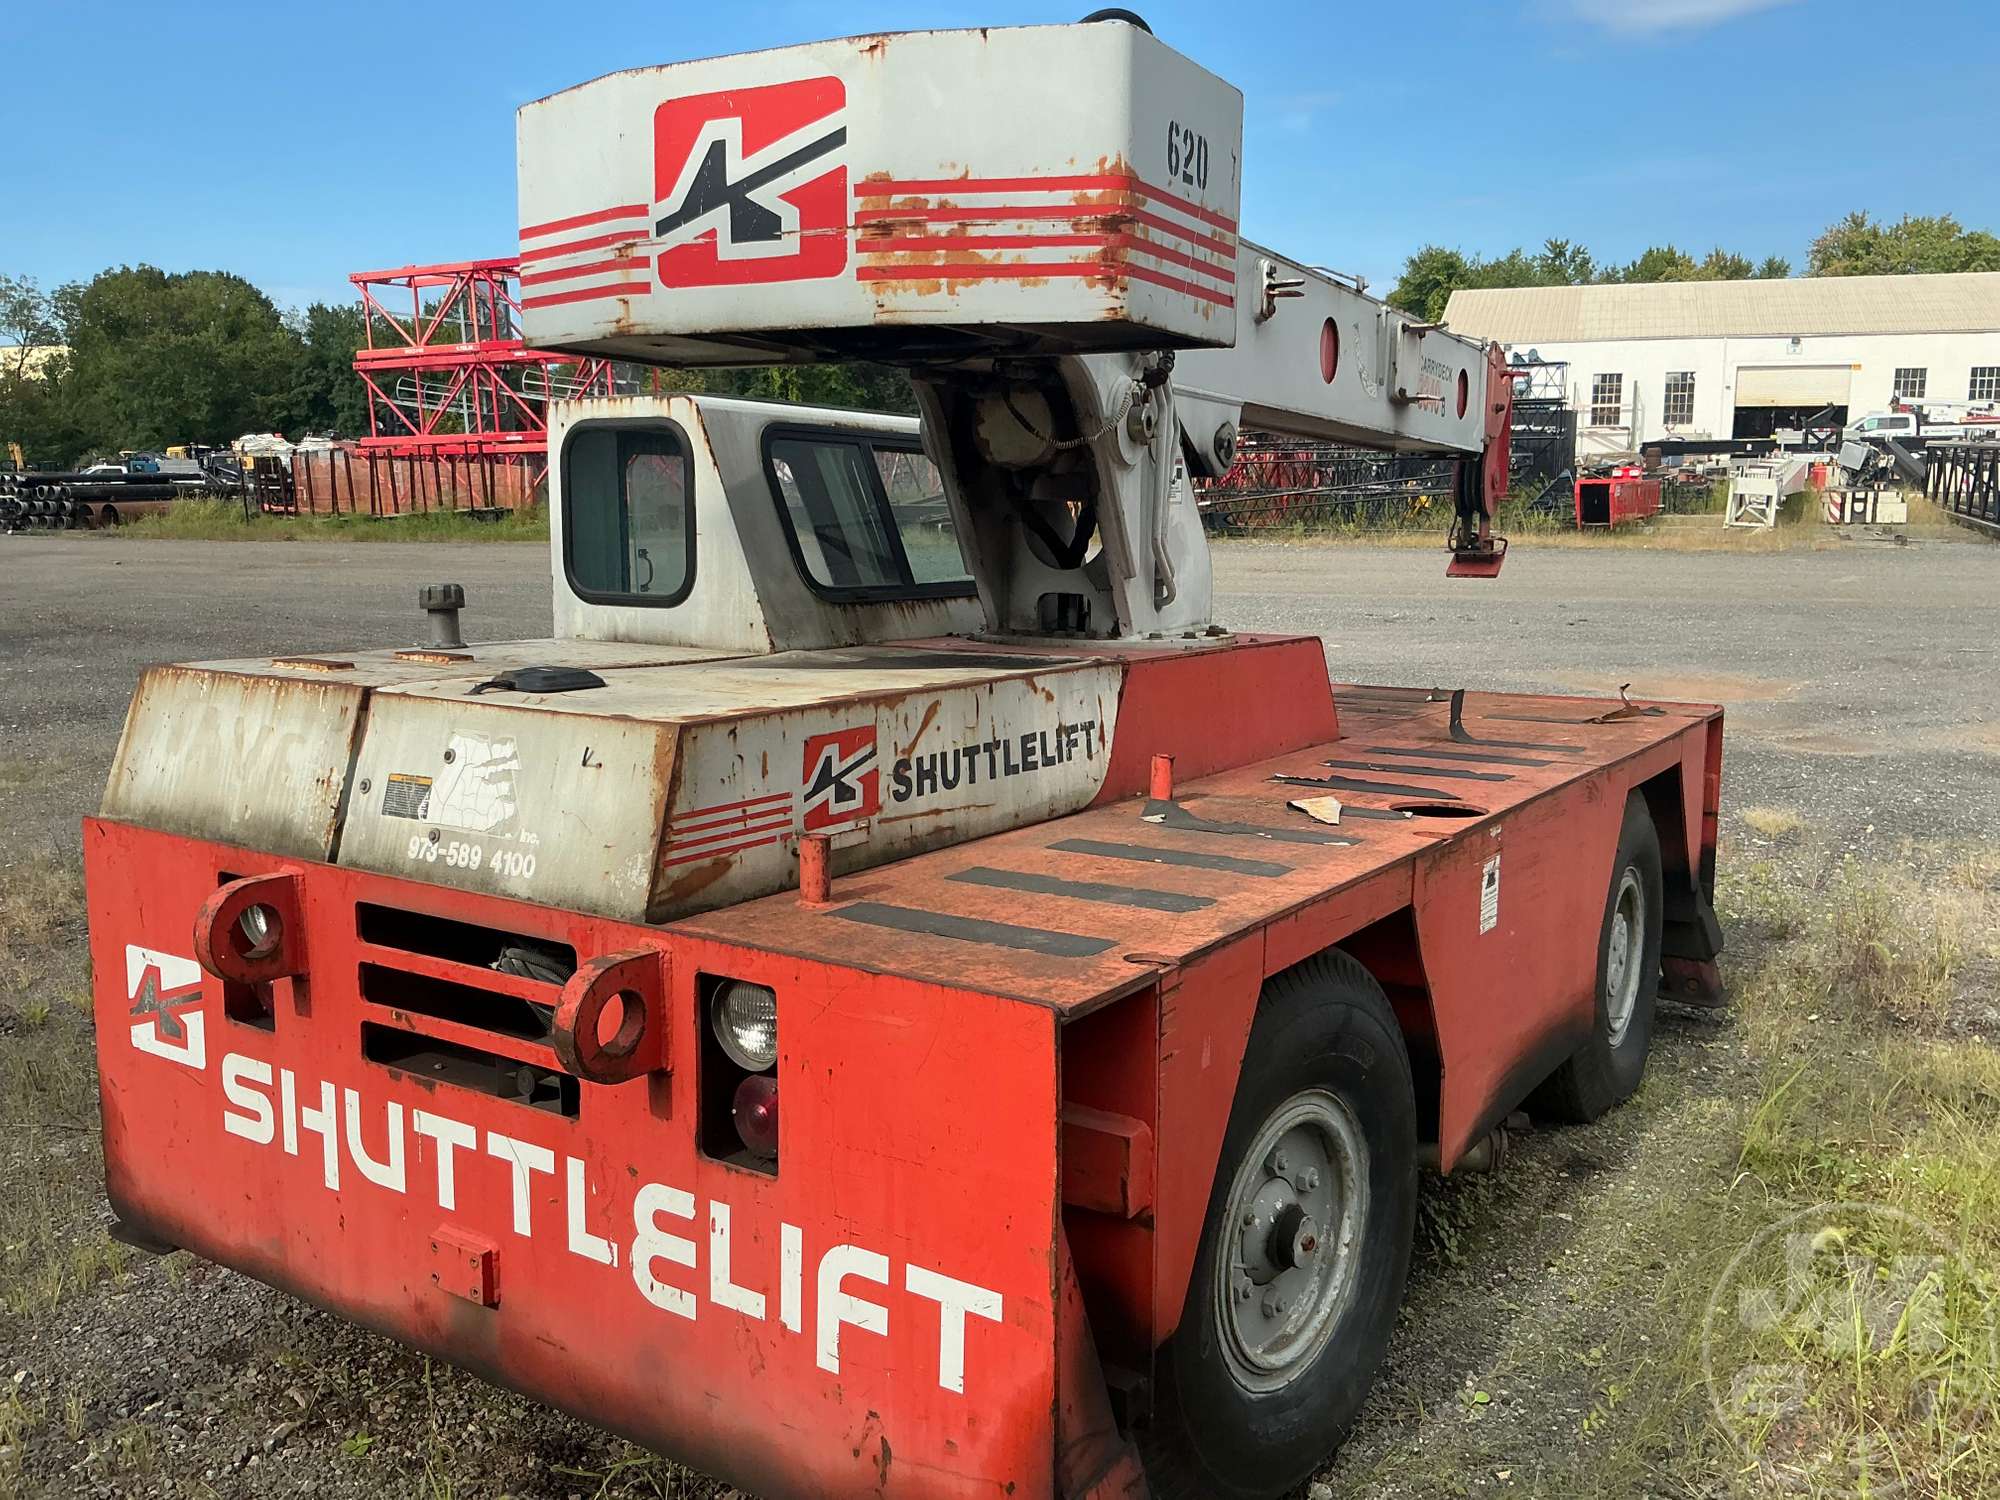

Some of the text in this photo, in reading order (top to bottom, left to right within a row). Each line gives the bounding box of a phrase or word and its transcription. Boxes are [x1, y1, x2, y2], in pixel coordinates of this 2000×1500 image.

[1167, 120, 1208, 190] 620
[892, 720, 1096, 802] SHUTTLELIFT
[407, 836, 537, 879] 973-589 4100
[221, 1051, 1004, 1395] SHUTTLELIFT
